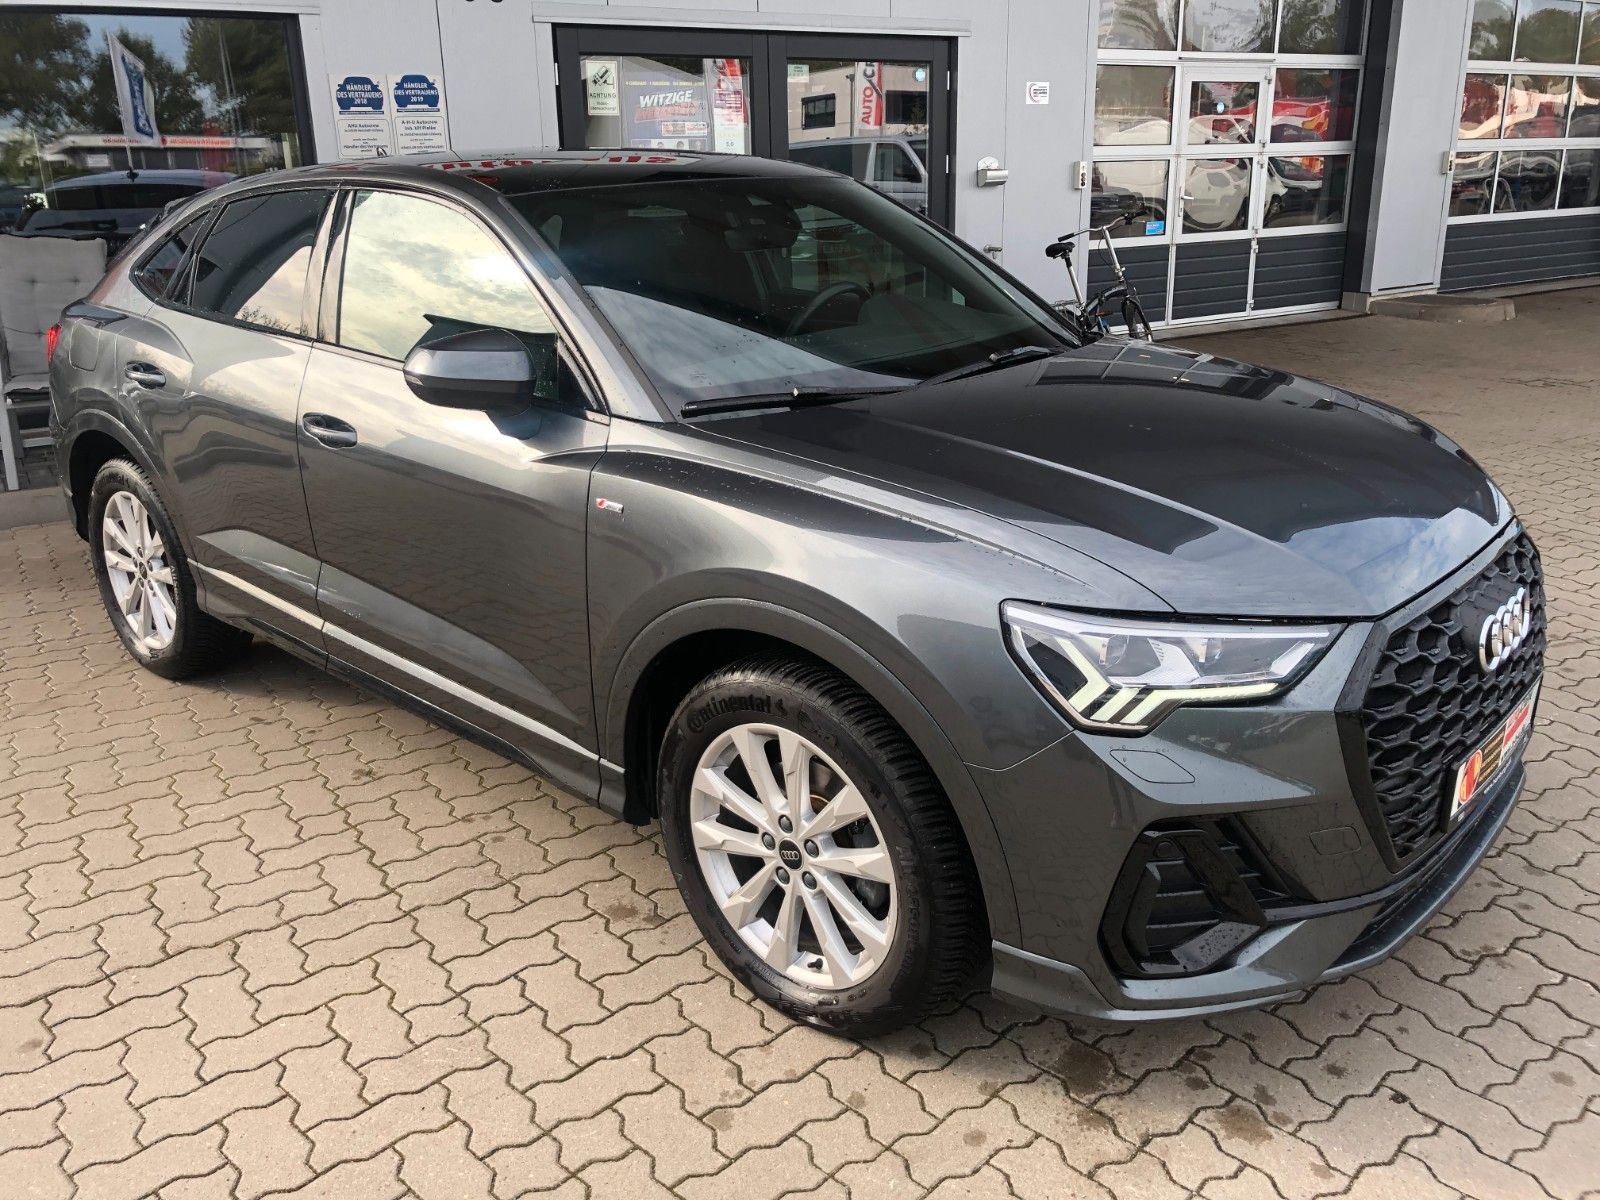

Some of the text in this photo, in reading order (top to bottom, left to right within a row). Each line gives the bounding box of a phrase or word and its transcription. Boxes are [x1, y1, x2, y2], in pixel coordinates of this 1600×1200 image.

[346, 82, 372, 91] HÄNDLER
[403, 81, 428, 89] HÄNDLER
[348, 91, 383, 99] VERTRAUENS
[639, 89, 694, 108] WITZIGE
[861, 86, 874, 125] AUTO
[687, 695, 771, 733] Continental
